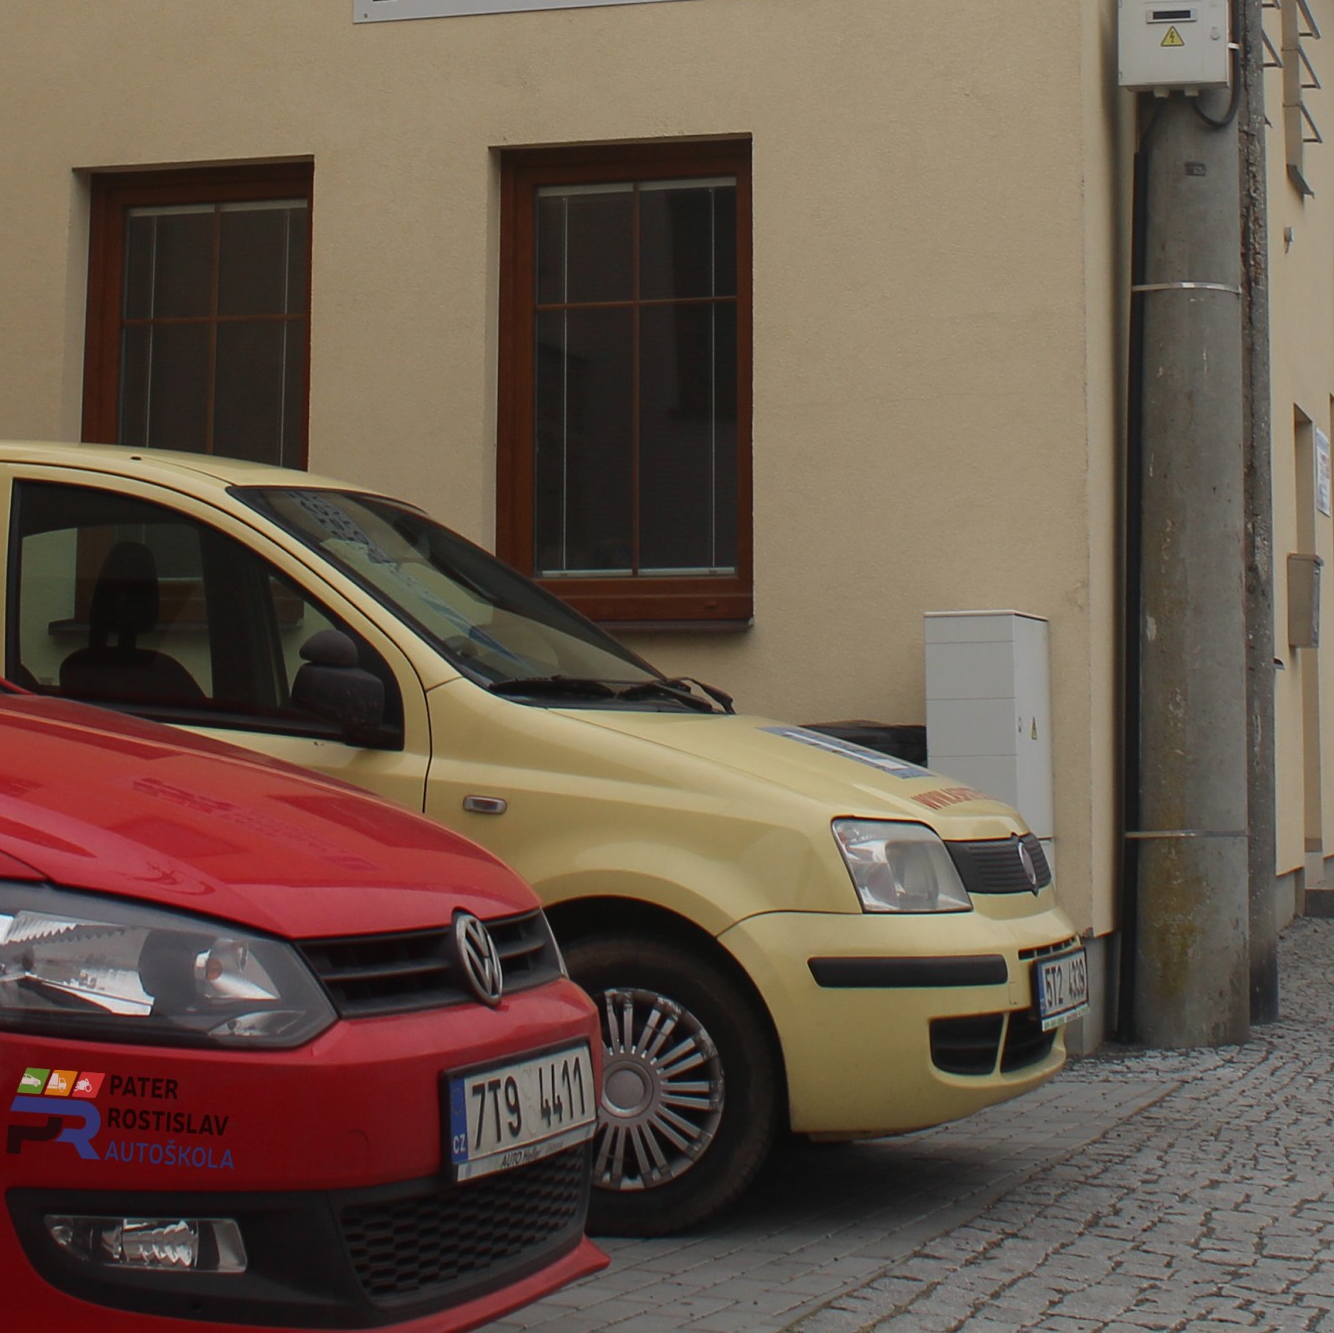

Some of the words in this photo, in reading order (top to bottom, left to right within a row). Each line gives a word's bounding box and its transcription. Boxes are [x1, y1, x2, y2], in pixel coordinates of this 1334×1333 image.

[109, 1074, 179, 1100] PATER
[472, 1075, 522, 1150] 7T9
[539, 1056, 585, 1128] 4411
[107, 1107, 229, 1136] ROSTISLAV
[104, 1140, 234, 1169] AUTOŠKOLA
[453, 1134, 466, 1154] CZ
